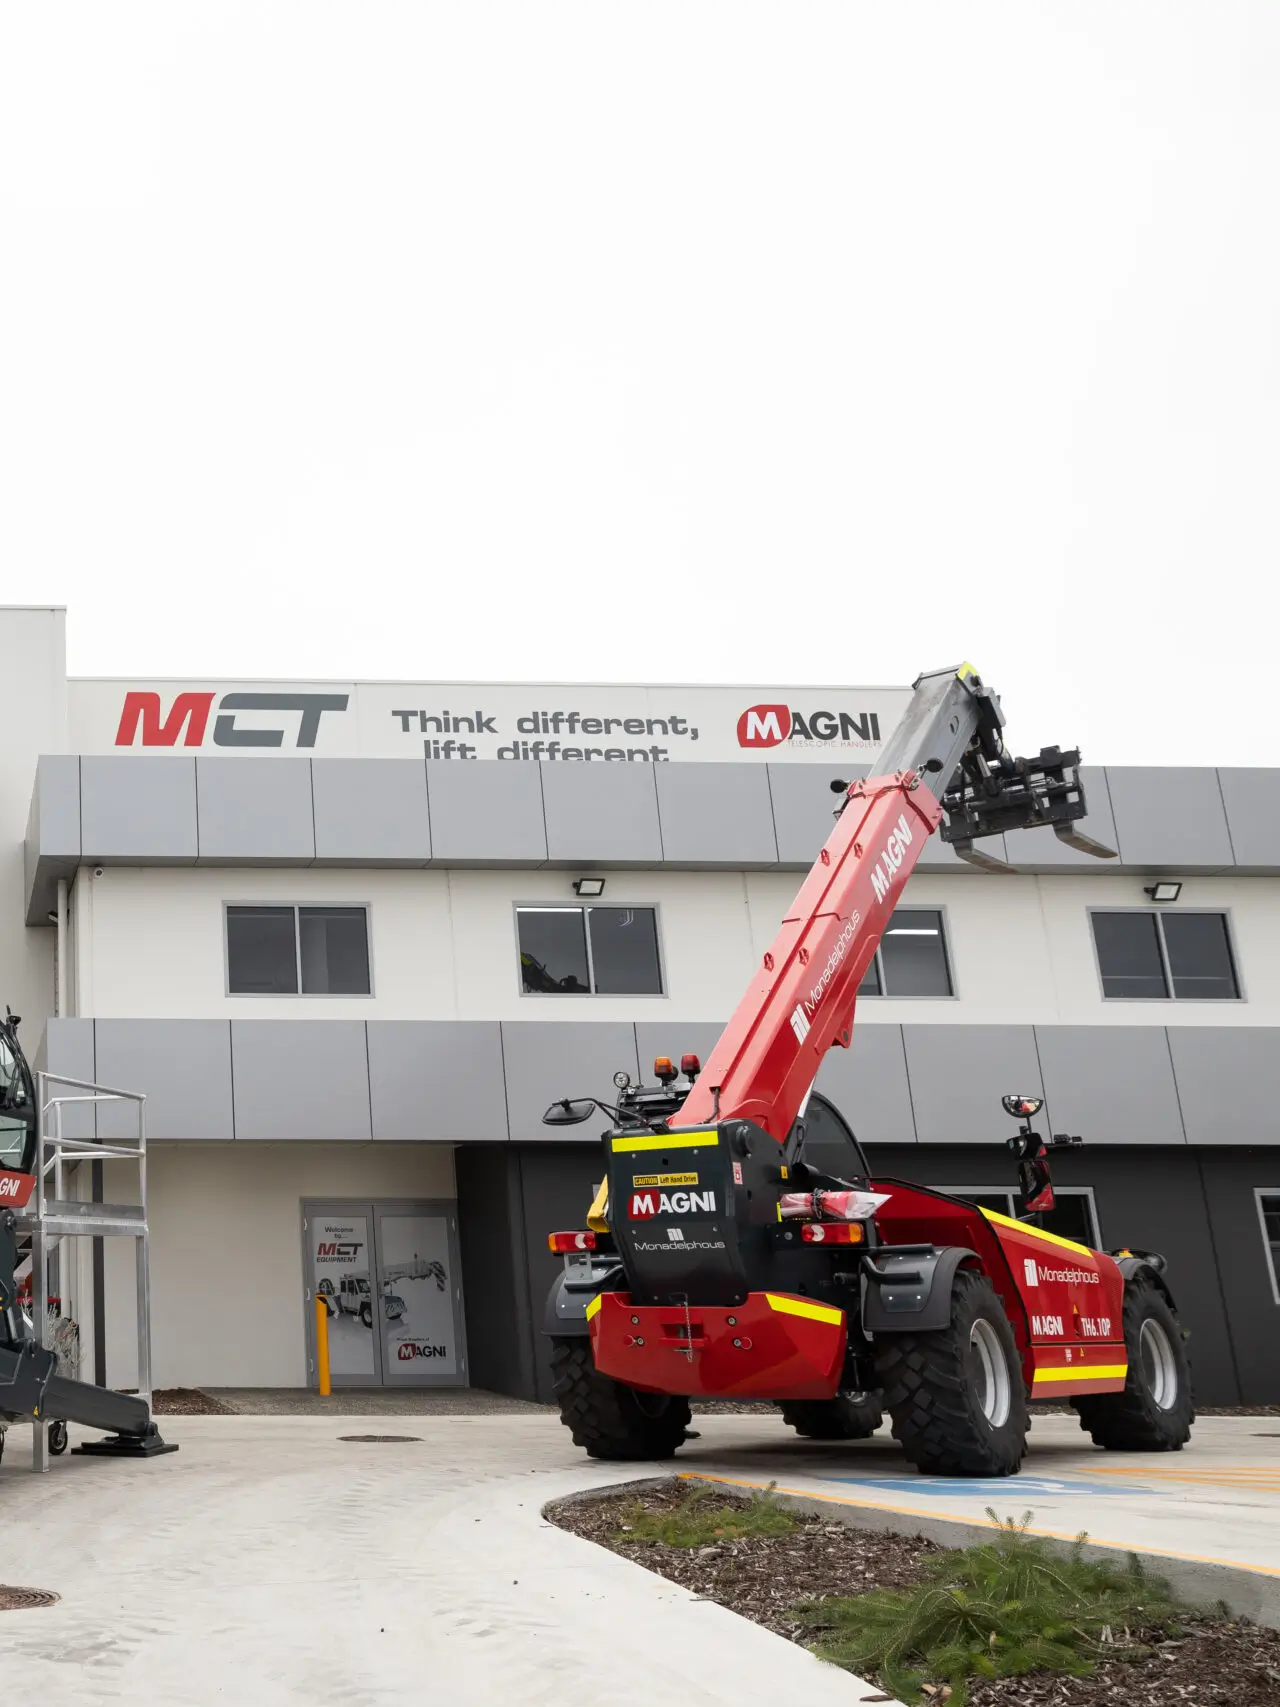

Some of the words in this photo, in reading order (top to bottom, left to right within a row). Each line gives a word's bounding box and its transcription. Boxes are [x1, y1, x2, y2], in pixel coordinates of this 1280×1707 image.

[114, 691, 349, 748] MCT
[391, 710, 498, 733] Think
[516, 711, 699, 740] different,
[746, 711, 881, 740] MAGNI
[423, 739, 477, 760] lift
[496, 740, 670, 762] different
[870, 814, 913, 904] MAGNI
[804, 909, 860, 1016] Monadelphous
[634, 1176, 659, 1186] CAUTION
[660, 1176, 670, 1184] Left
[670, 1175, 683, 1184] Hand
[683, 1174, 697, 1183] Drive
[632, 1191, 717, 1215] MAGNI
[317, 1243, 364, 1256] MCT
[634, 1241, 725, 1251] Monadelphous
[1038, 1266, 1099, 1286] Monadelphous
[1031, 1315, 1064, 1336] MAGNI
[400, 1345, 446, 1358] MAGNI
